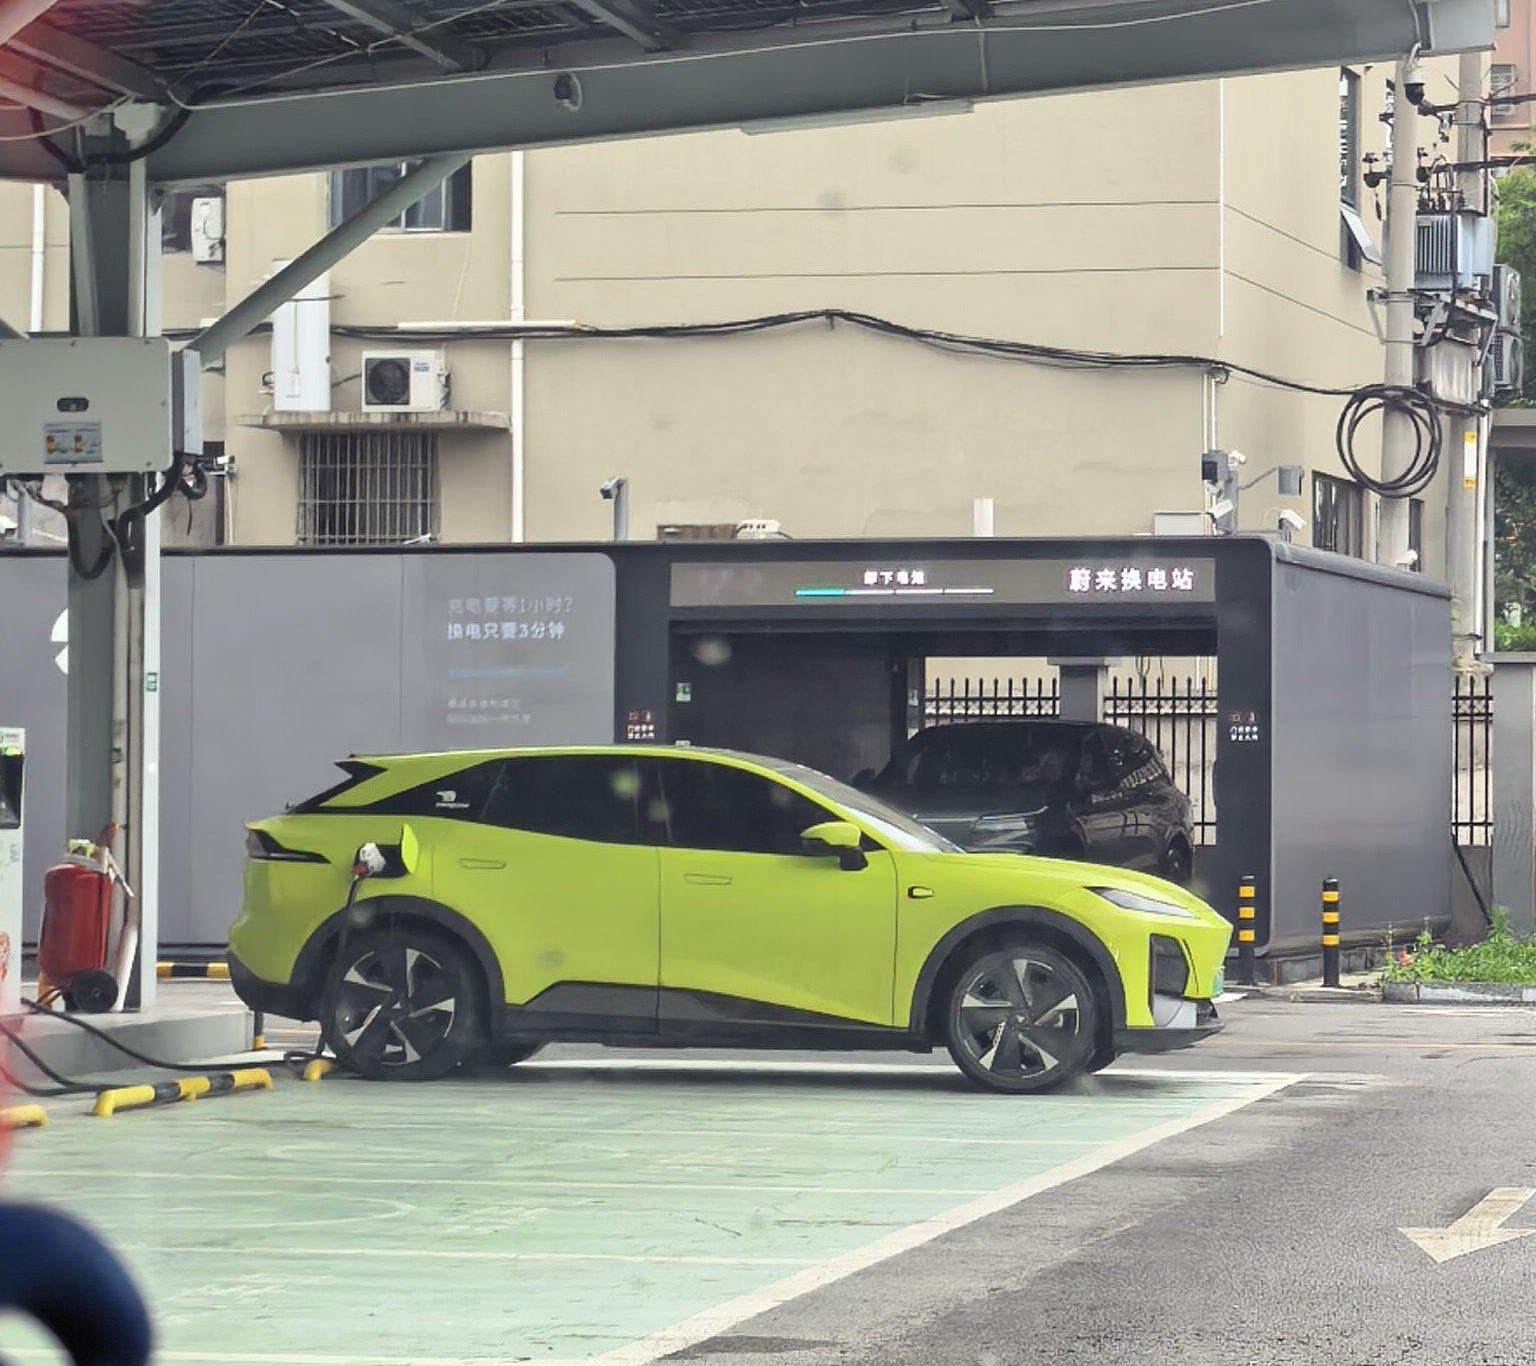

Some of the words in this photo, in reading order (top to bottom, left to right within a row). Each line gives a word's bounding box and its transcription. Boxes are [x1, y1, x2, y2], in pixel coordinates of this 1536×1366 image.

[1069, 567, 1194, 592] 蔚来换电站
